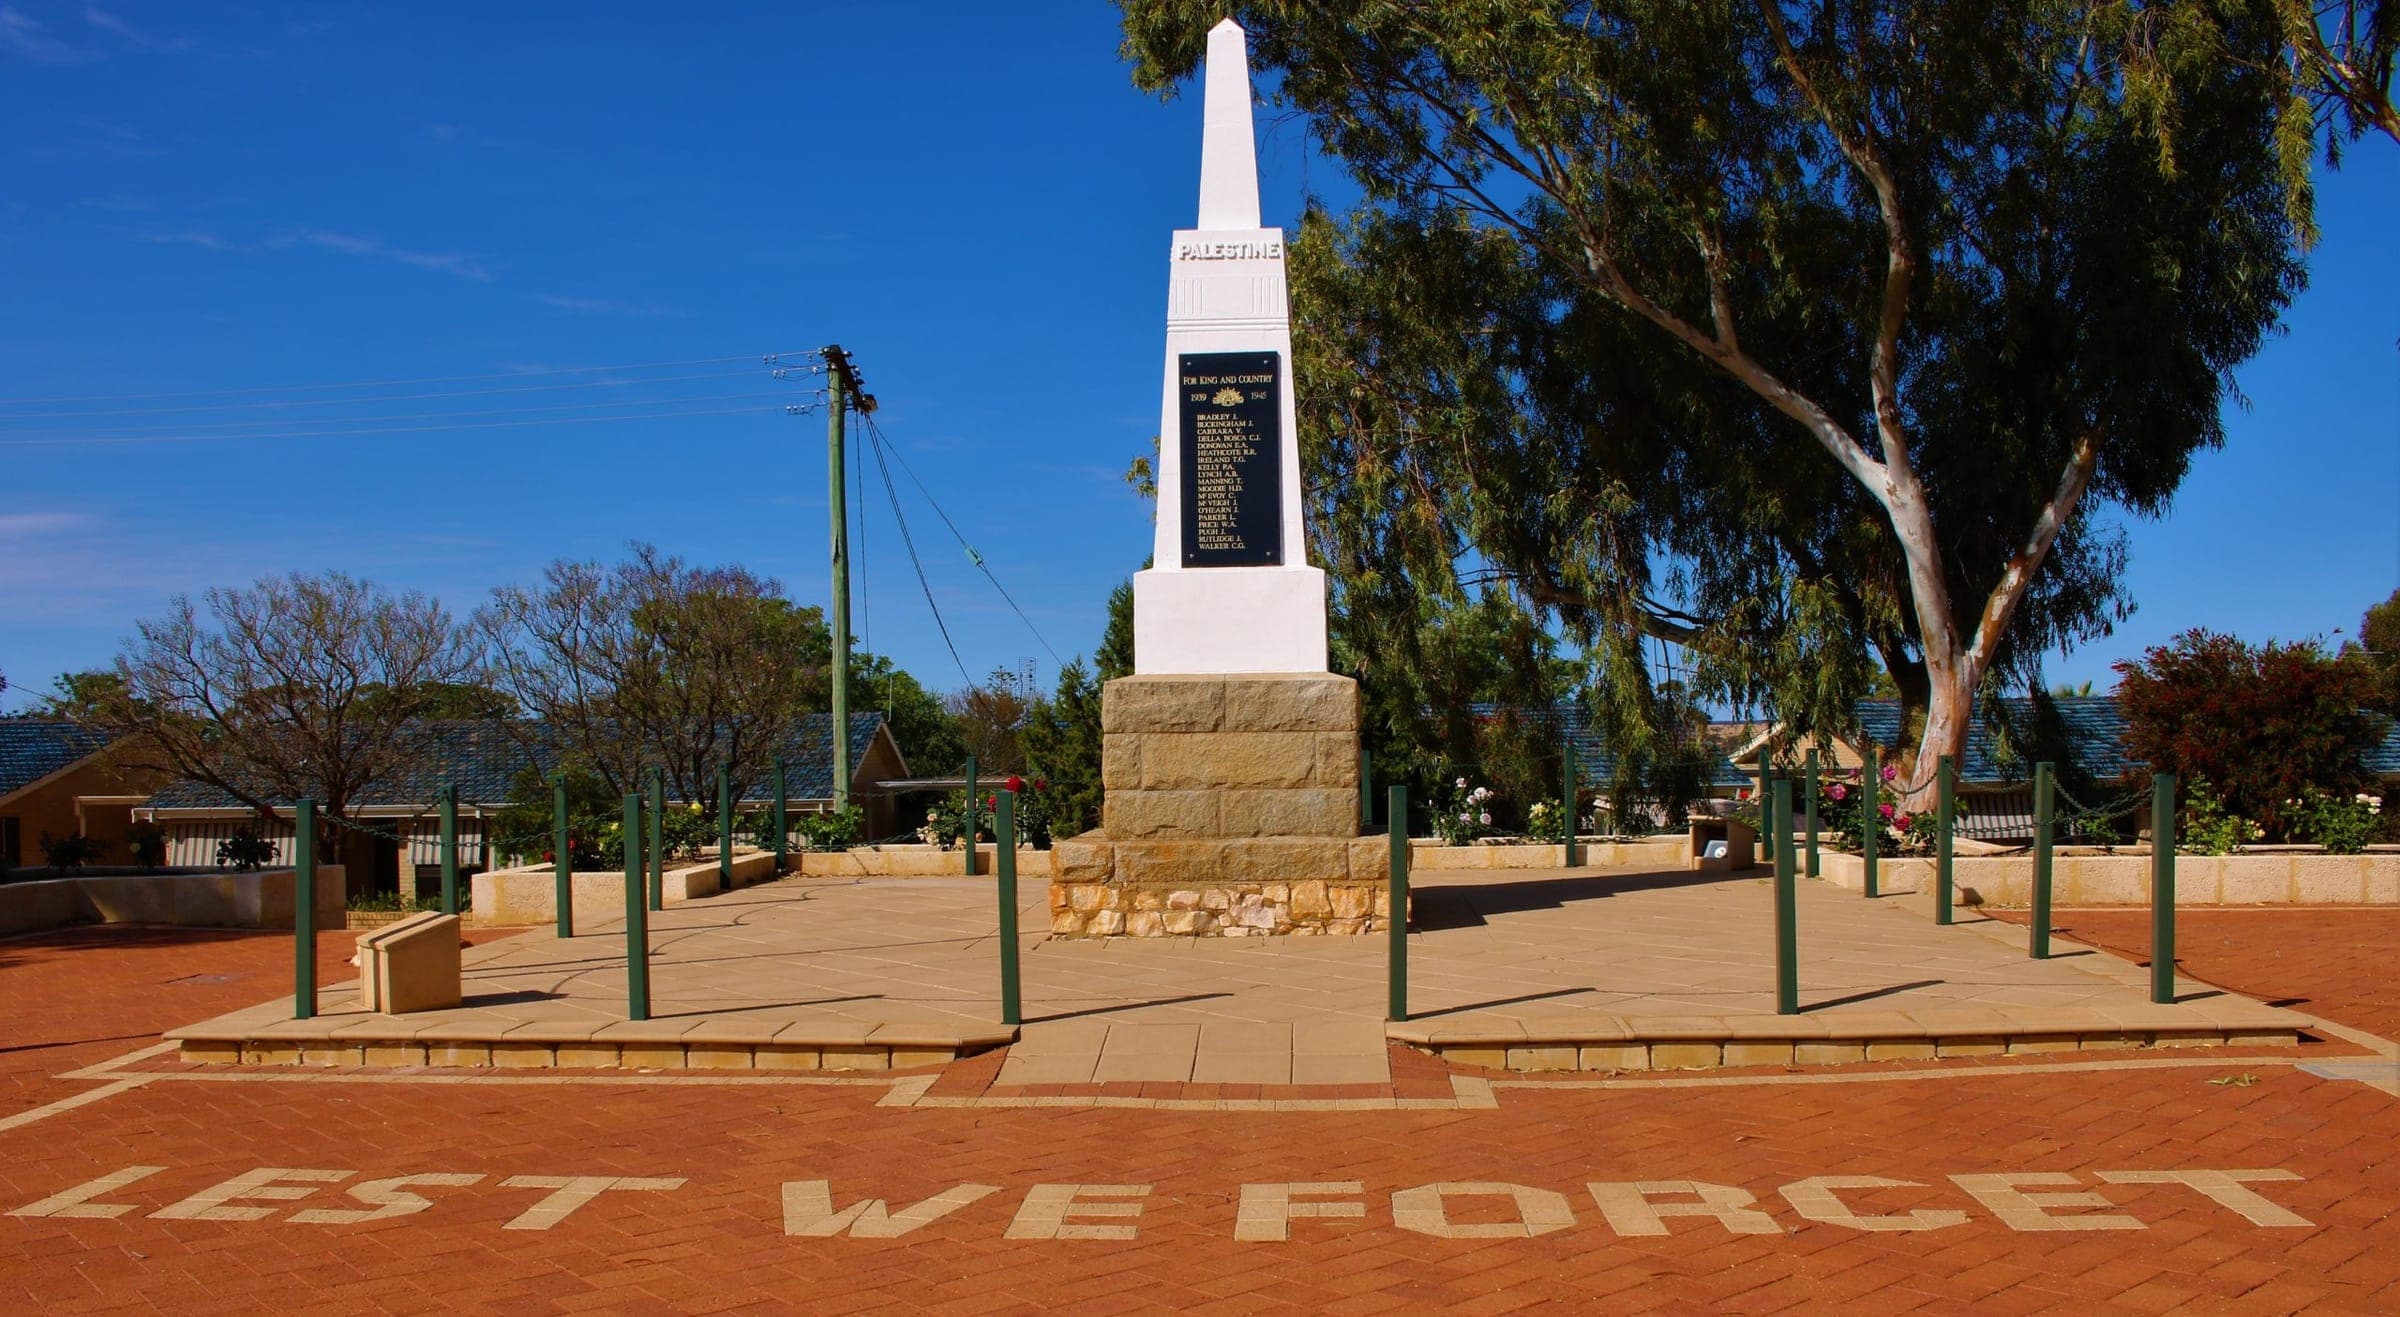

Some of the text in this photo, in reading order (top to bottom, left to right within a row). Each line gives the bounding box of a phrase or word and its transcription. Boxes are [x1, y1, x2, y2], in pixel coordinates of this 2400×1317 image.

[1178, 241, 1280, 261] PALESTINE
[1183, 374, 1273, 385] FOR KING AND COUNTRY
[1191, 391, 1267, 402] 1939 1945
[3, 1166, 2317, 1241] LEST WE FORGET
